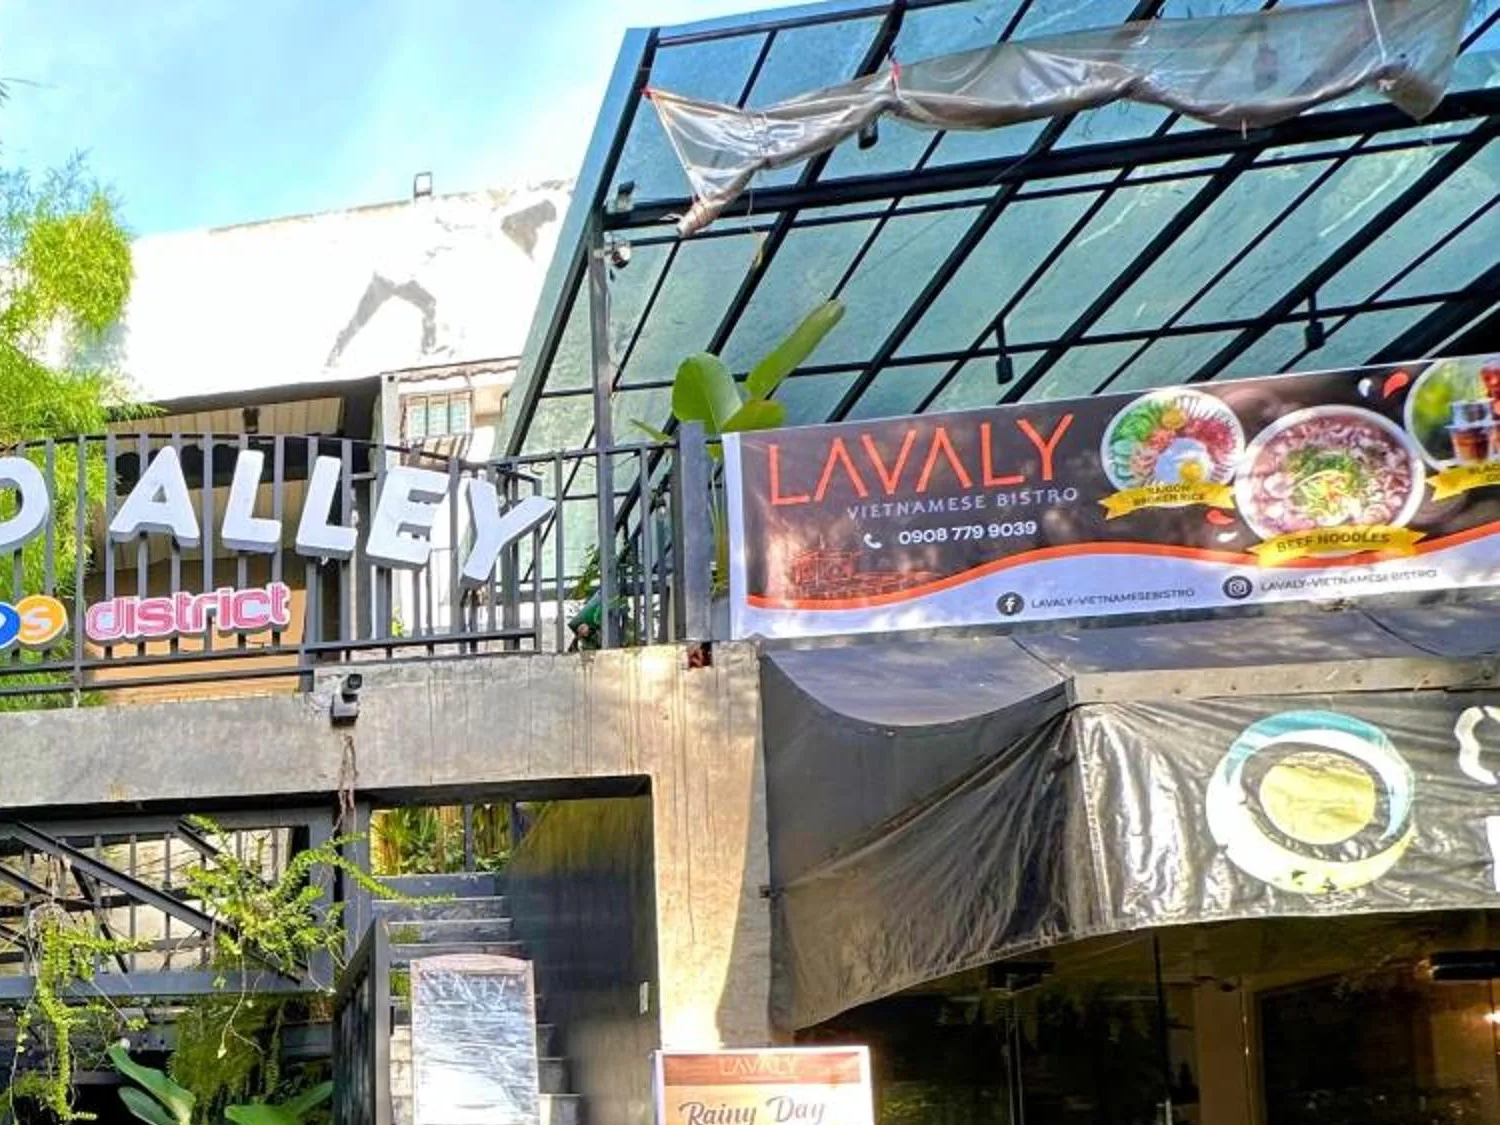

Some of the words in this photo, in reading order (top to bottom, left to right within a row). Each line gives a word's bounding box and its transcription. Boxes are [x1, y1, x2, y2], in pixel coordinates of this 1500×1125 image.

[767, 413, 1075, 506] LAVALY
[110, 446, 556, 589] ALLEY
[847, 495, 987, 520] VIETNAMESE
[996, 487, 1079, 507] BISTRO
[899, 528, 948, 545] 0908
[951, 525, 984, 541] 779
[988, 521, 1038, 539] 9039
[1277, 535, 1314, 552] BEEF
[1318, 531, 1391, 545] NOODLES
[86, 582, 291, 640] district
